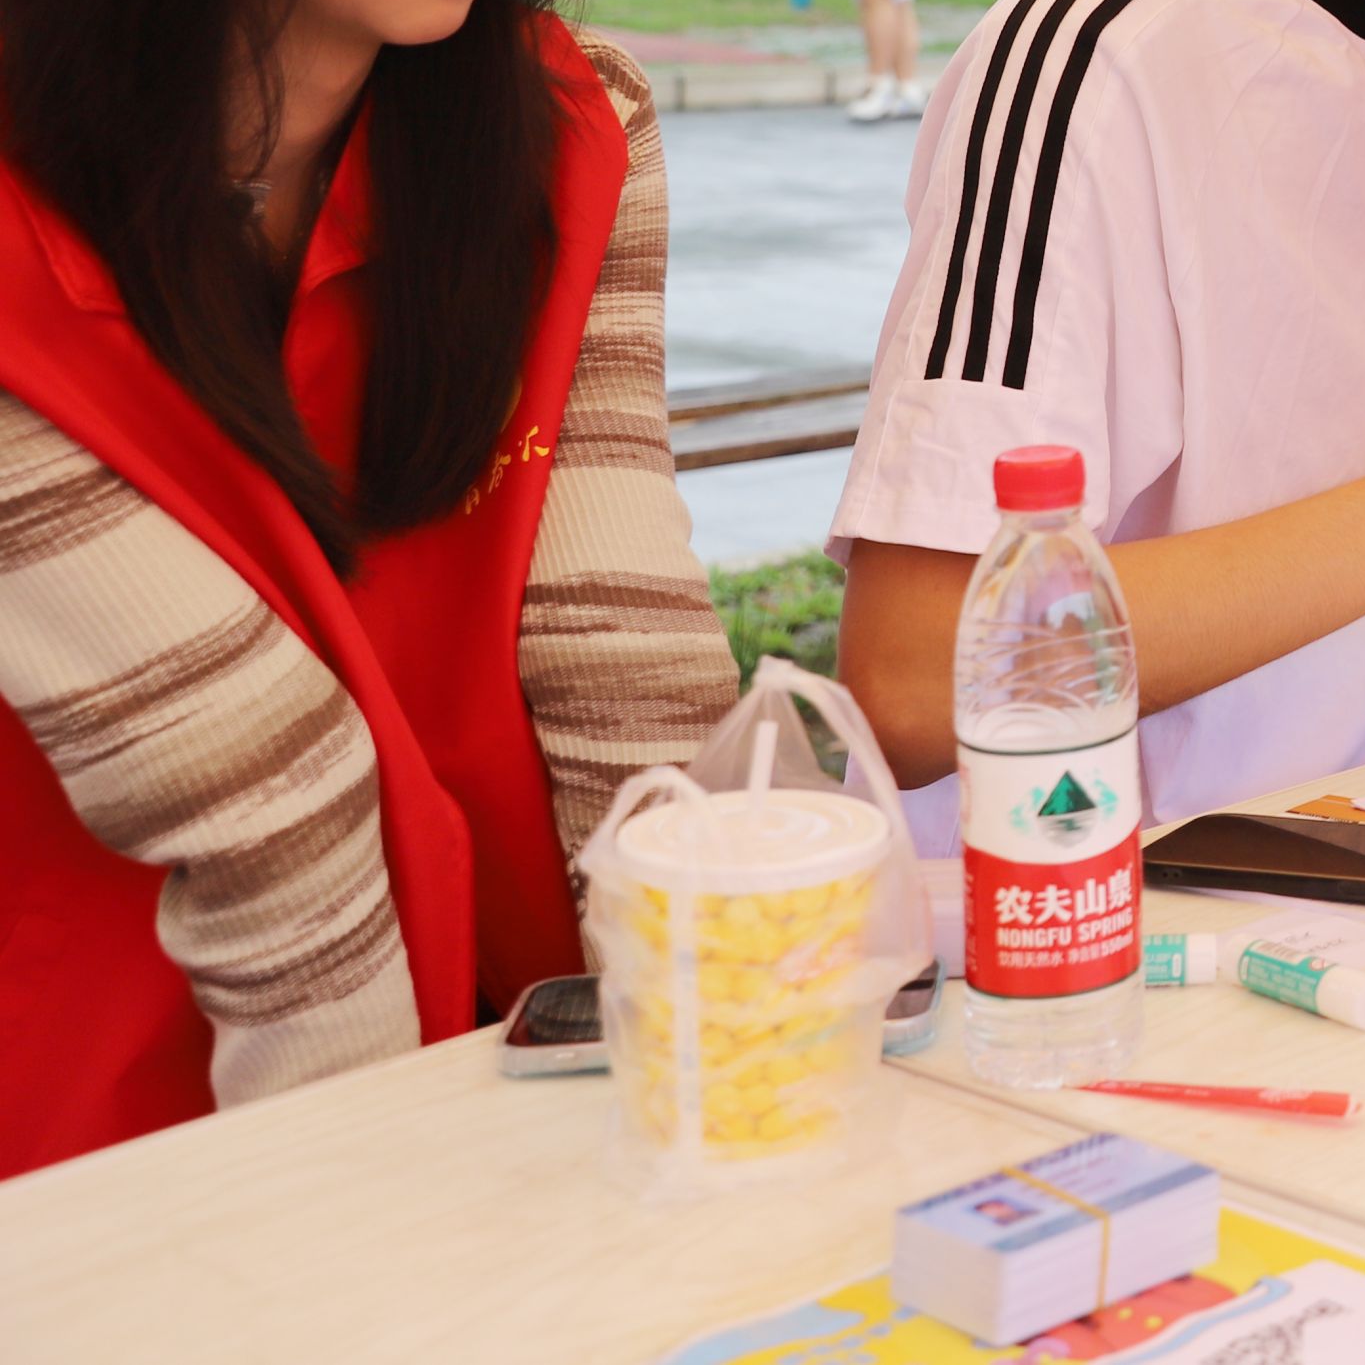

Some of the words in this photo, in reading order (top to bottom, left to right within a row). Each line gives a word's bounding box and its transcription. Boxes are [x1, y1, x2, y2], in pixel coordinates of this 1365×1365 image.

[995, 869, 1133, 925] 农夫山泉
[996, 926, 1073, 949] NONGFU
[1077, 905, 1134, 942] SPRING
